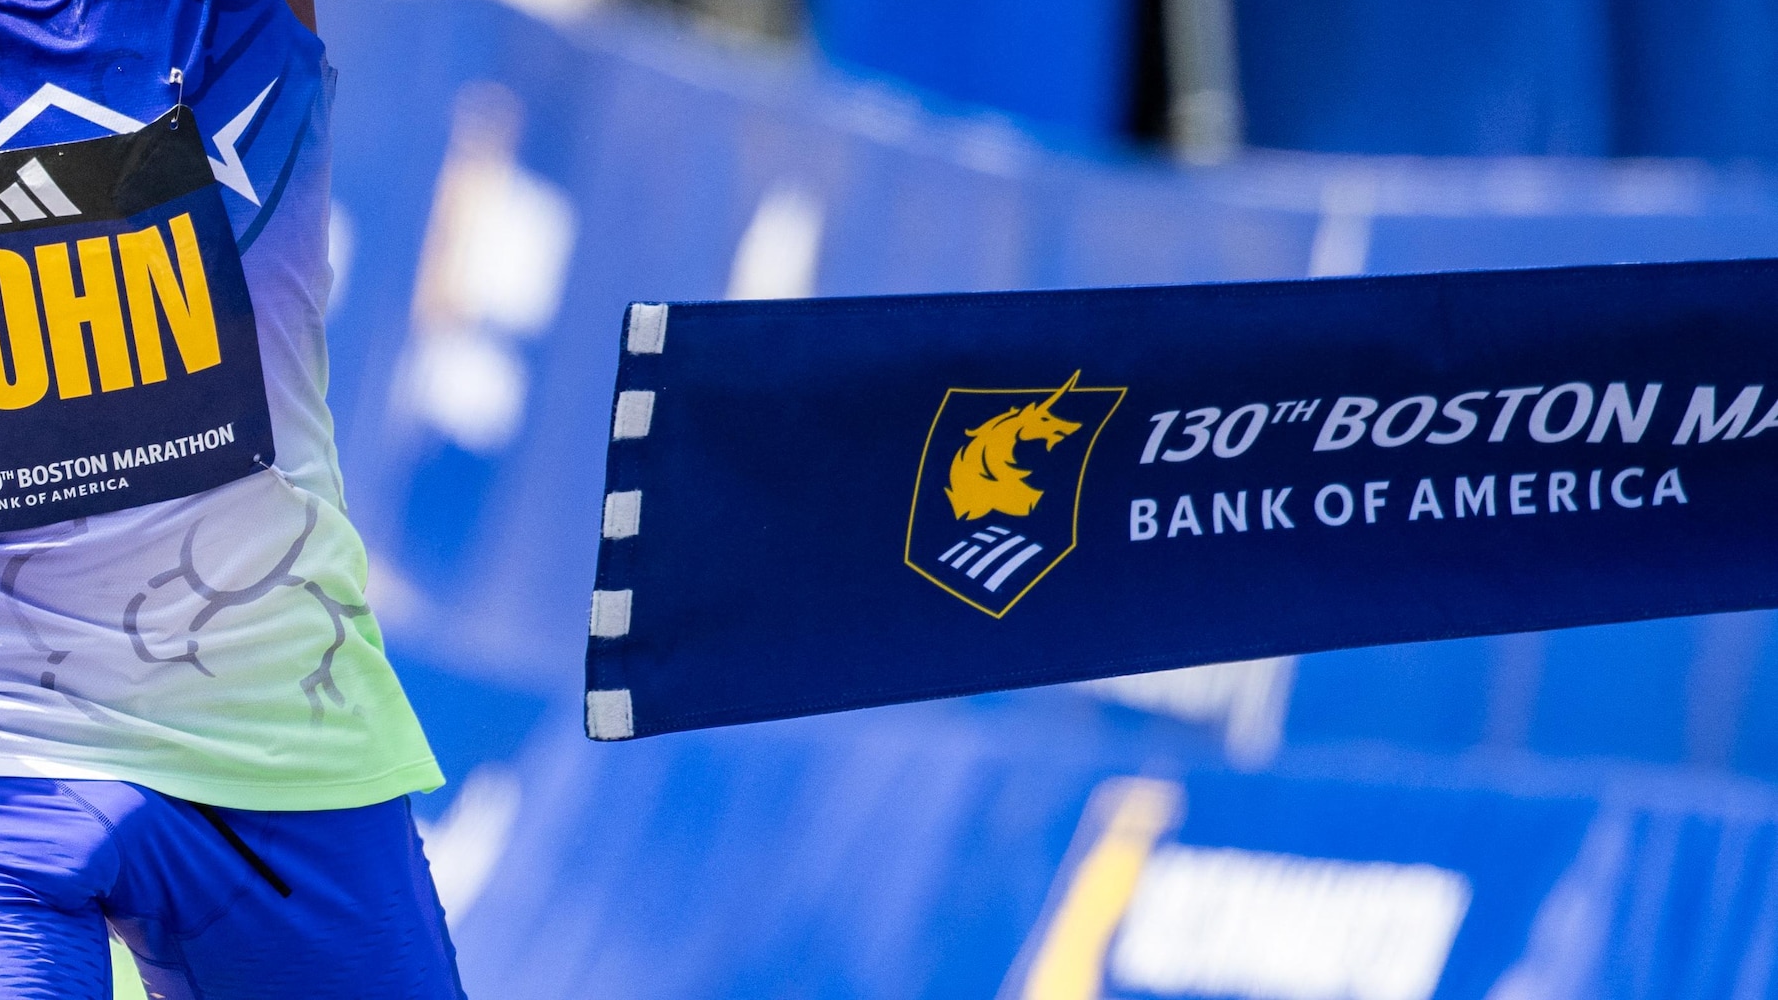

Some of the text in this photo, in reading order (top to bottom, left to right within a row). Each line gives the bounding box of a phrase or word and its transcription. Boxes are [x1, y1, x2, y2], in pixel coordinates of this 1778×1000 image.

[18, 454, 108, 489] BOSTON
[112, 423, 235, 471] MARATHON
[1139, 398, 1320, 465] 130TH
[1312, 382, 1662, 453] BOSTON
[25, 493, 46, 507] OF
[51, 477, 130, 503] AMERICA
[1129, 467, 1689, 541] BANK OF AMERICA
